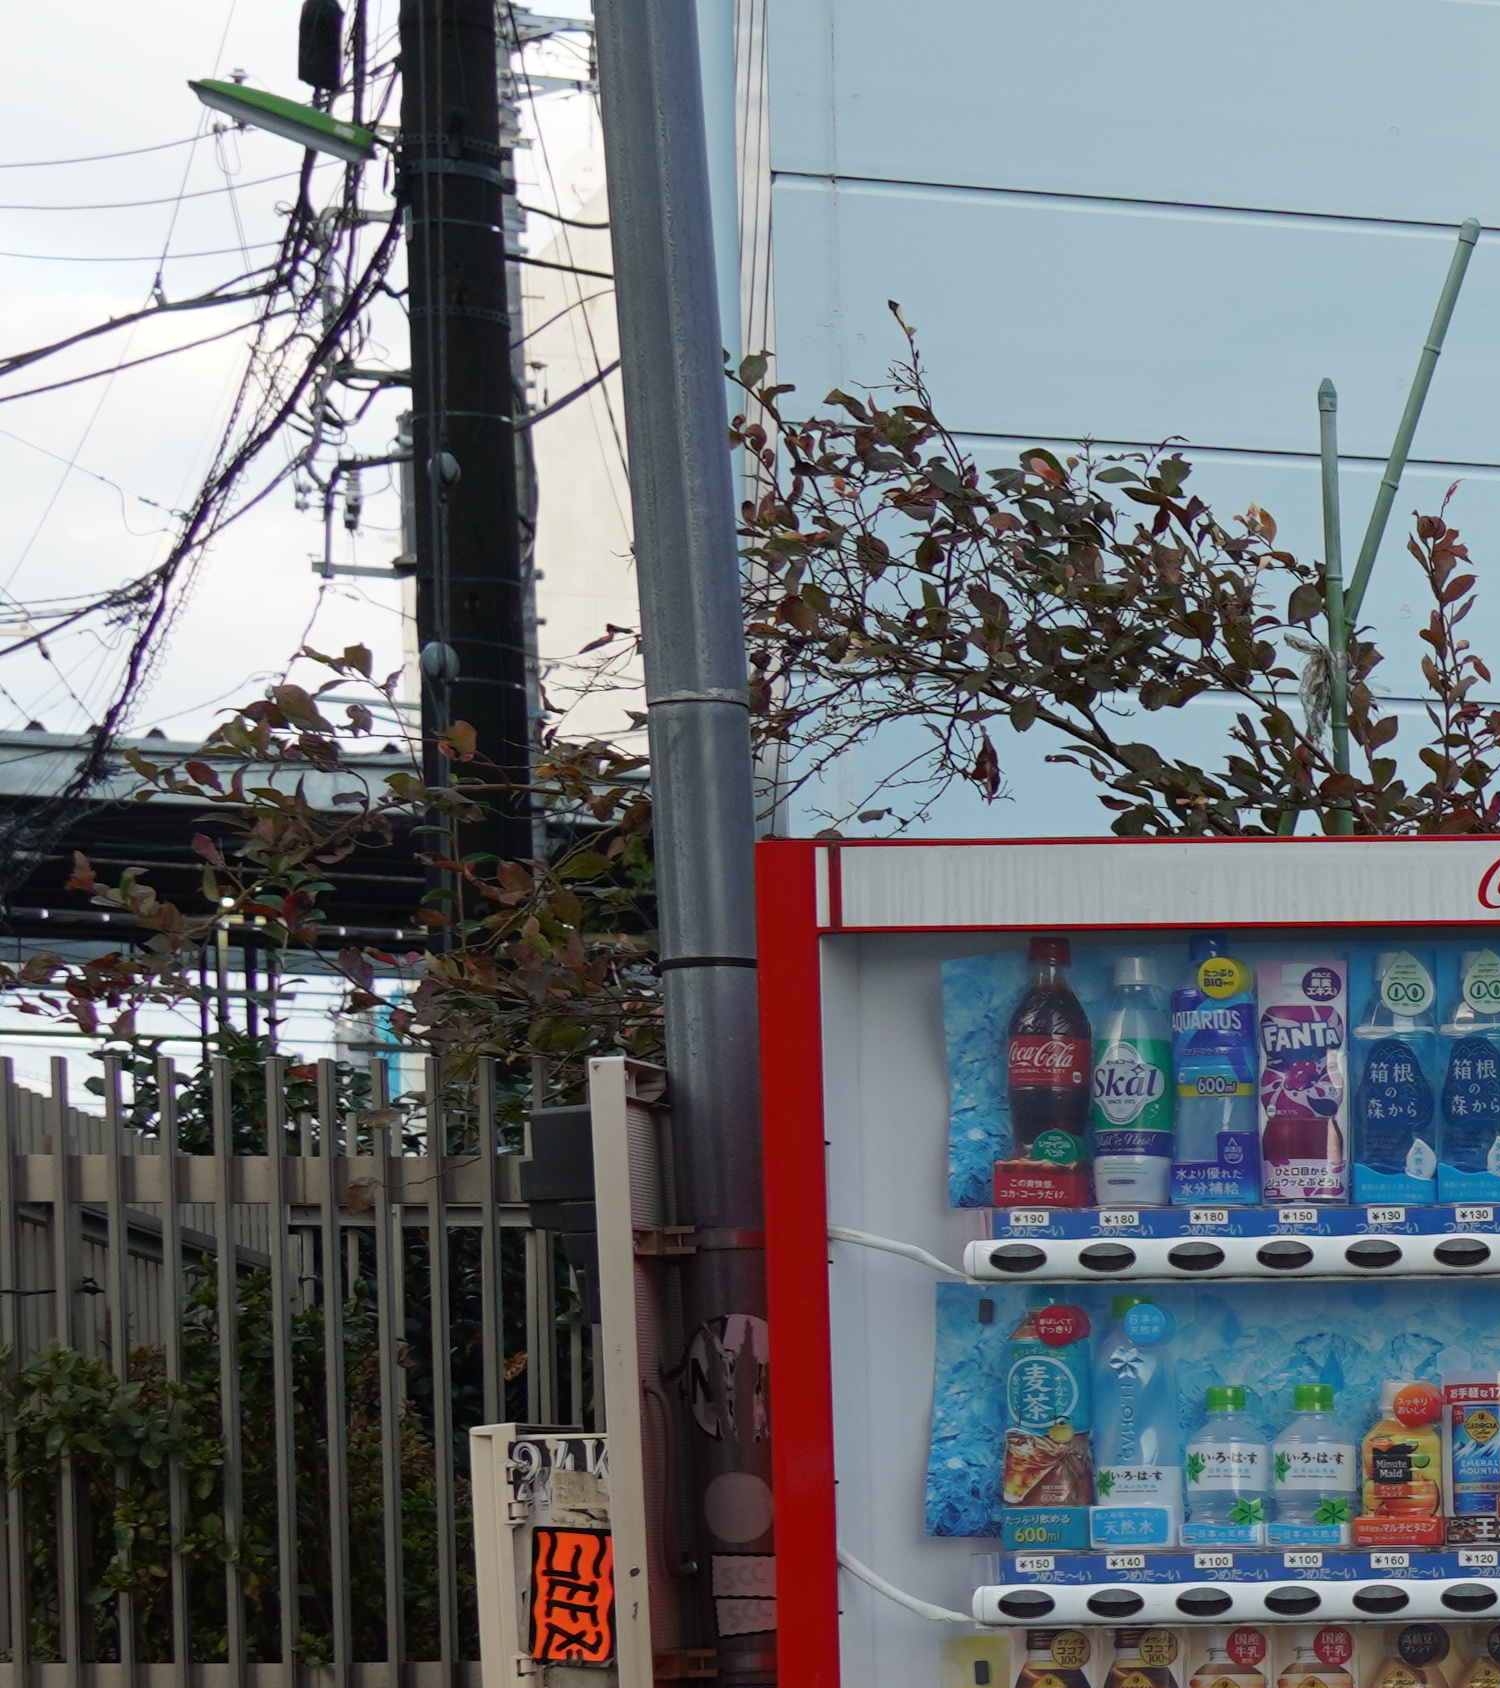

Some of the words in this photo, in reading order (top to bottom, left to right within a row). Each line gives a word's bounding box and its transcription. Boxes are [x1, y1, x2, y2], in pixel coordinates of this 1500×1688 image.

[1171, 1009, 1242, 1031] AQUARIUS
[1263, 1020, 1340, 1051] FANTA
[1008, 1041, 1076, 1070] Coca-Cola
[1369, 1061, 1414, 1084] 箱根
[1197, 1076, 1237, 1095] 600ml
[1367, 1098, 1418, 1120] 森から
[1181, 1182, 1239, 1196] 水分補給
[1022, 1363, 1051, 1421] 麦茶
[1376, 1459, 1408, 1469] Minute
[1379, 1468, 1403, 1479] Maid
[1014, 1527, 1061, 1543] 600ml
[1103, 1519, 1154, 1534] 天然水
